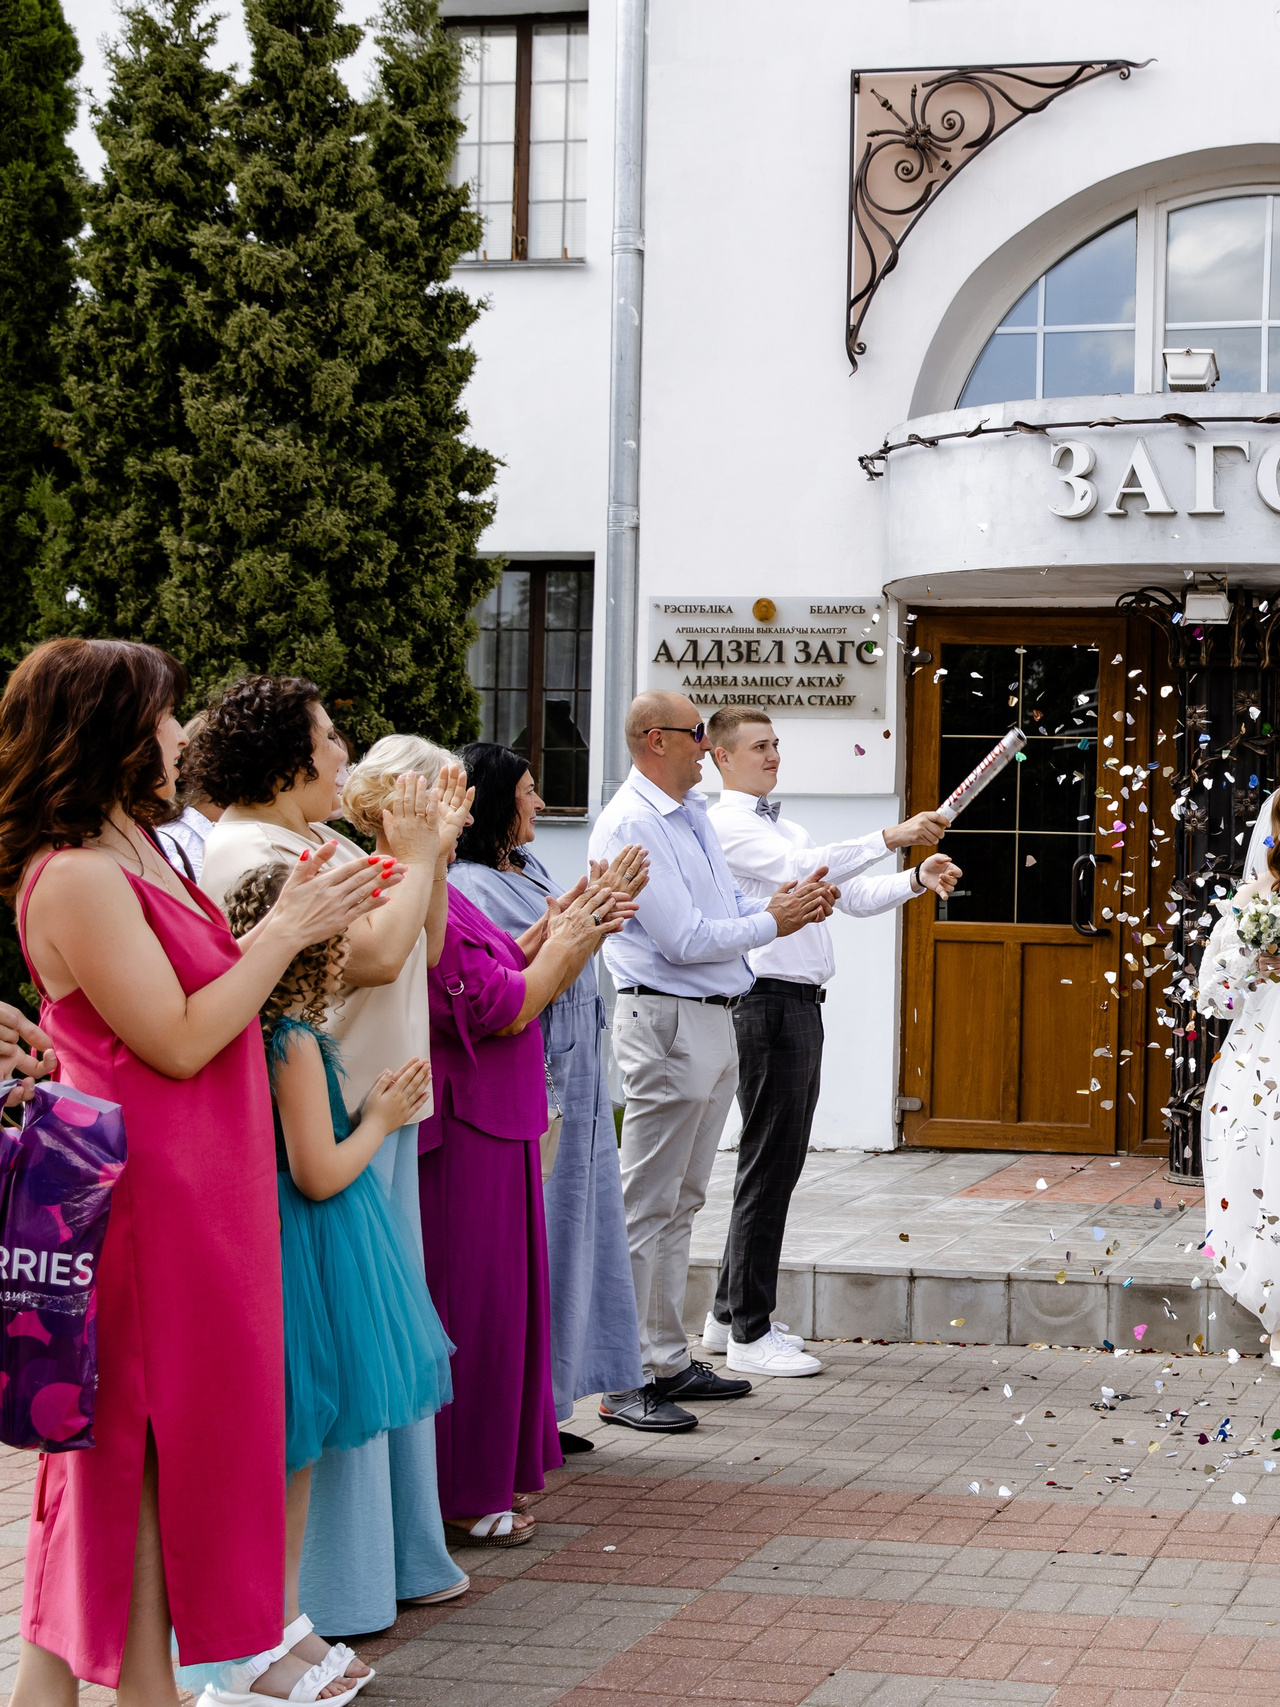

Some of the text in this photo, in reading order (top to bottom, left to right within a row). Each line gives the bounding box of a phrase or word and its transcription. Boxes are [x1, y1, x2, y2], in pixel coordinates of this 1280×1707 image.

[664, 604, 865, 614] РЭСПУБЛІКА БЕЛАРУСЬ
[721, 626, 754, 634] РАЁННЫ
[757, 626, 809, 634] ВЫКАНАЎЧЫ
[652, 639, 878, 669] АДДЗЕЛ ЗАГС
[682, 673, 845, 689] АДДЗЕЛ ЗАПІСУ АКТАЎ
[682, 693, 857, 707] АМАДЗЯНСКАГА СТАНУ
